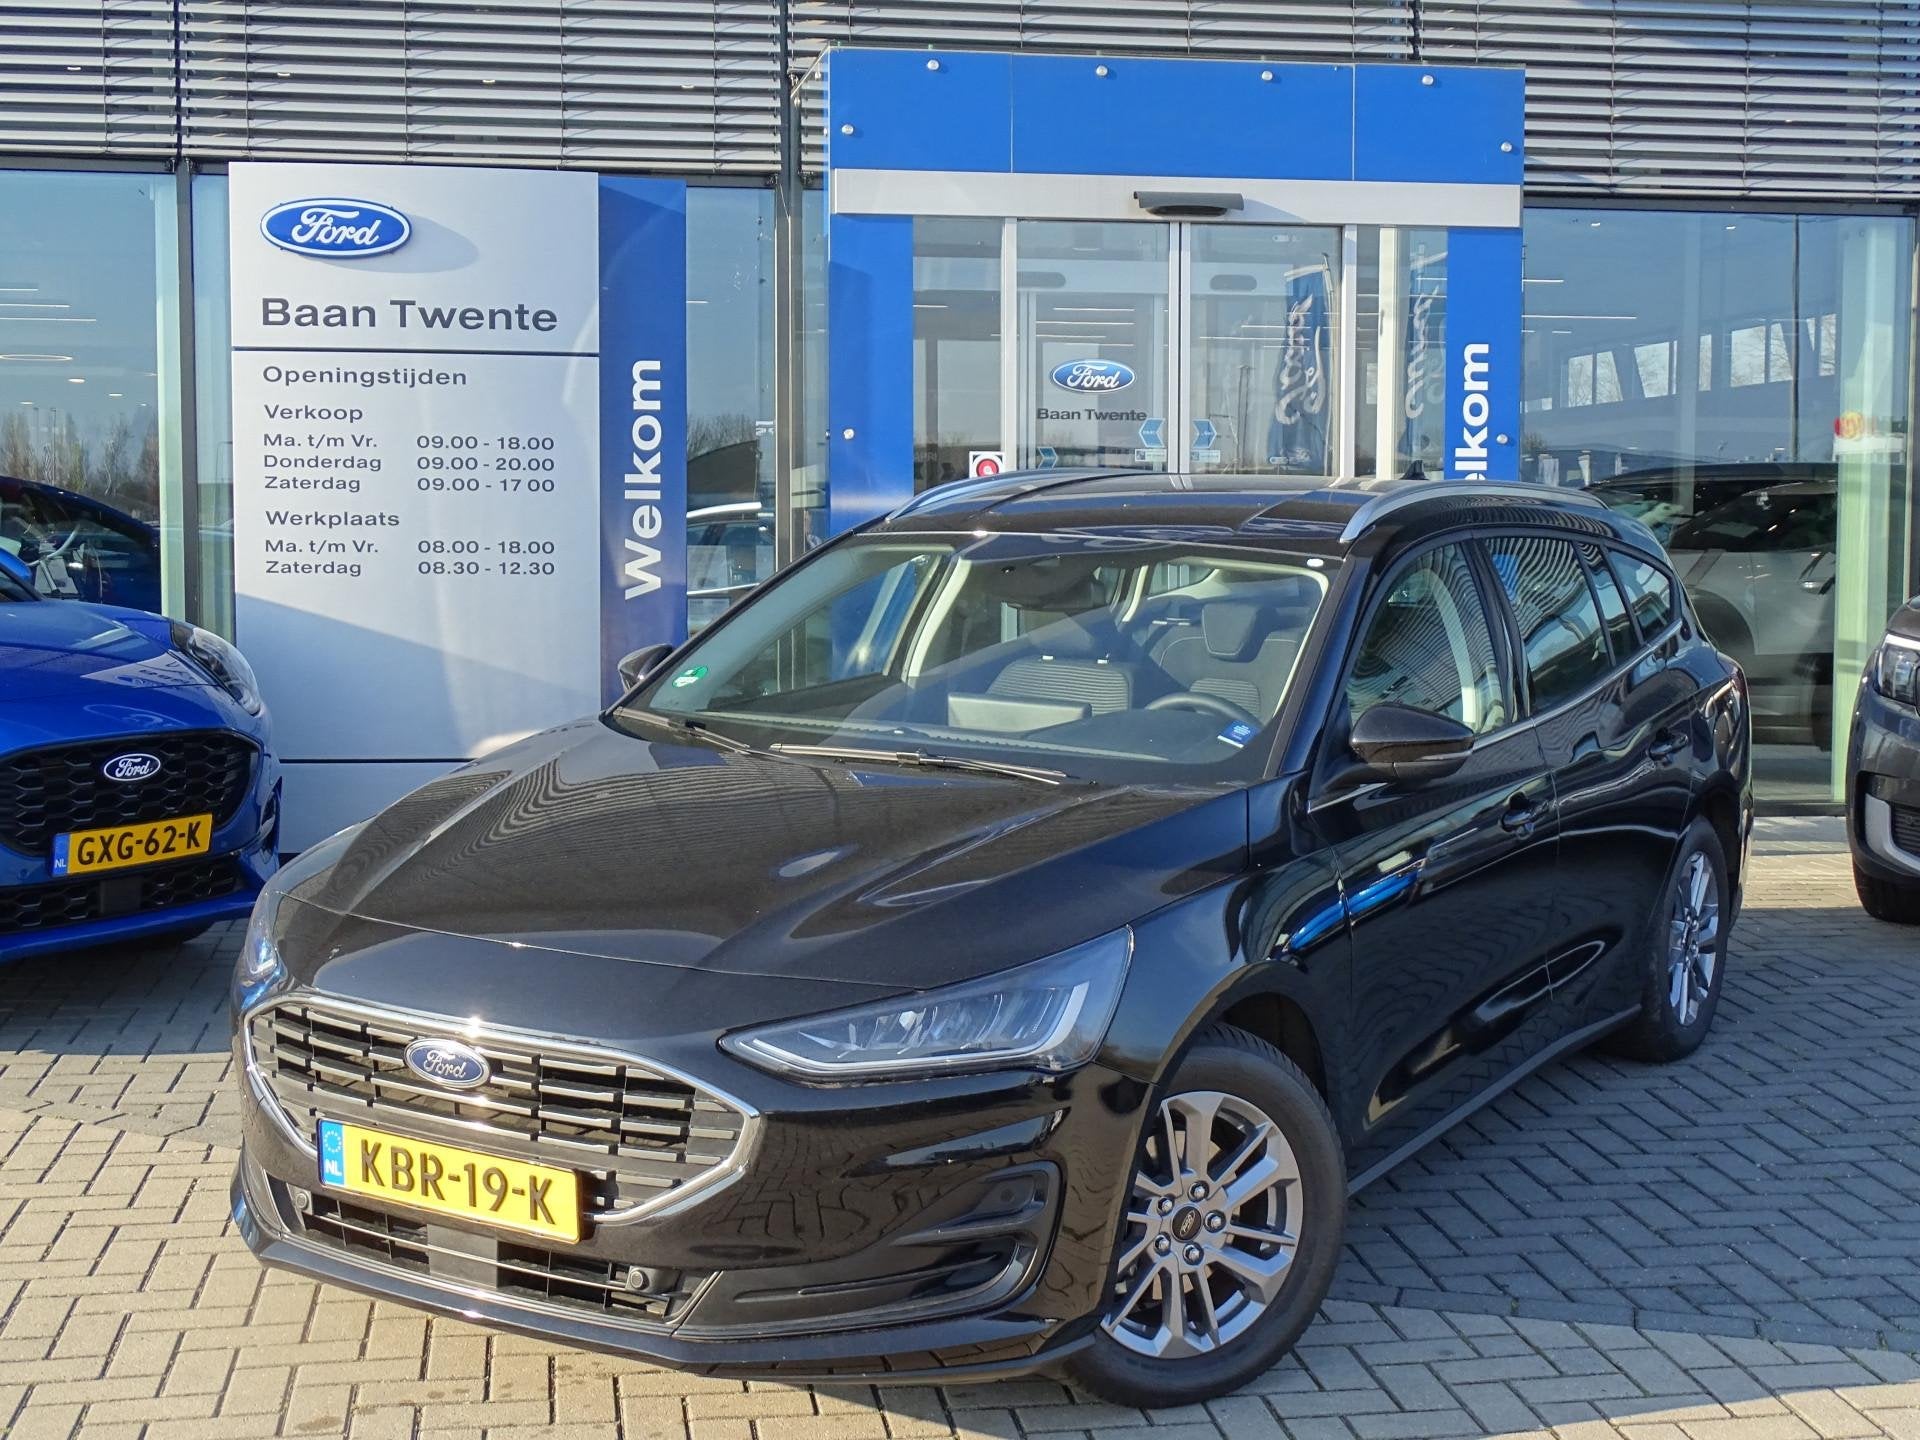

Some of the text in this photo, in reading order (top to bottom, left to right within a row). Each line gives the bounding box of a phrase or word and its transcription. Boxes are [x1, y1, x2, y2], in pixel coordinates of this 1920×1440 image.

[290, 206, 382, 248] Ford
[261, 297, 558, 332] Baan Twente
[262, 365, 467, 388] Openingstijden
[1066, 364, 1121, 389] Ford
[263, 404, 363, 424] Verkoop
[1036, 407, 1148, 422] Baan Twente
[263, 433, 377, 449] Ma. t/m Vr.
[416, 435, 479, 449] 09.00
[497, 436, 555, 450] 18.00
[263, 454, 382, 472] Donderdag
[416, 456, 479, 470] 09.00
[495, 457, 555, 471] 20.00
[264, 475, 361, 493] Zaterdag
[417, 477, 480, 491] 09.00
[624, 360, 662, 600] Welkom
[265, 510, 401, 529] Werkplaats
[265, 539, 379, 555] Ma. t/m Vr.
[417, 539, 480, 554] 08.00
[497, 540, 555, 554] 18.00
[265, 560, 362, 578] Zaterdag
[417, 561, 480, 575] 08.30
[498, 561, 555, 575] 12.30
[54, 820, 202, 869] NL GXG-62-K
[324, 1138, 556, 1225] NL KBR-19-K
